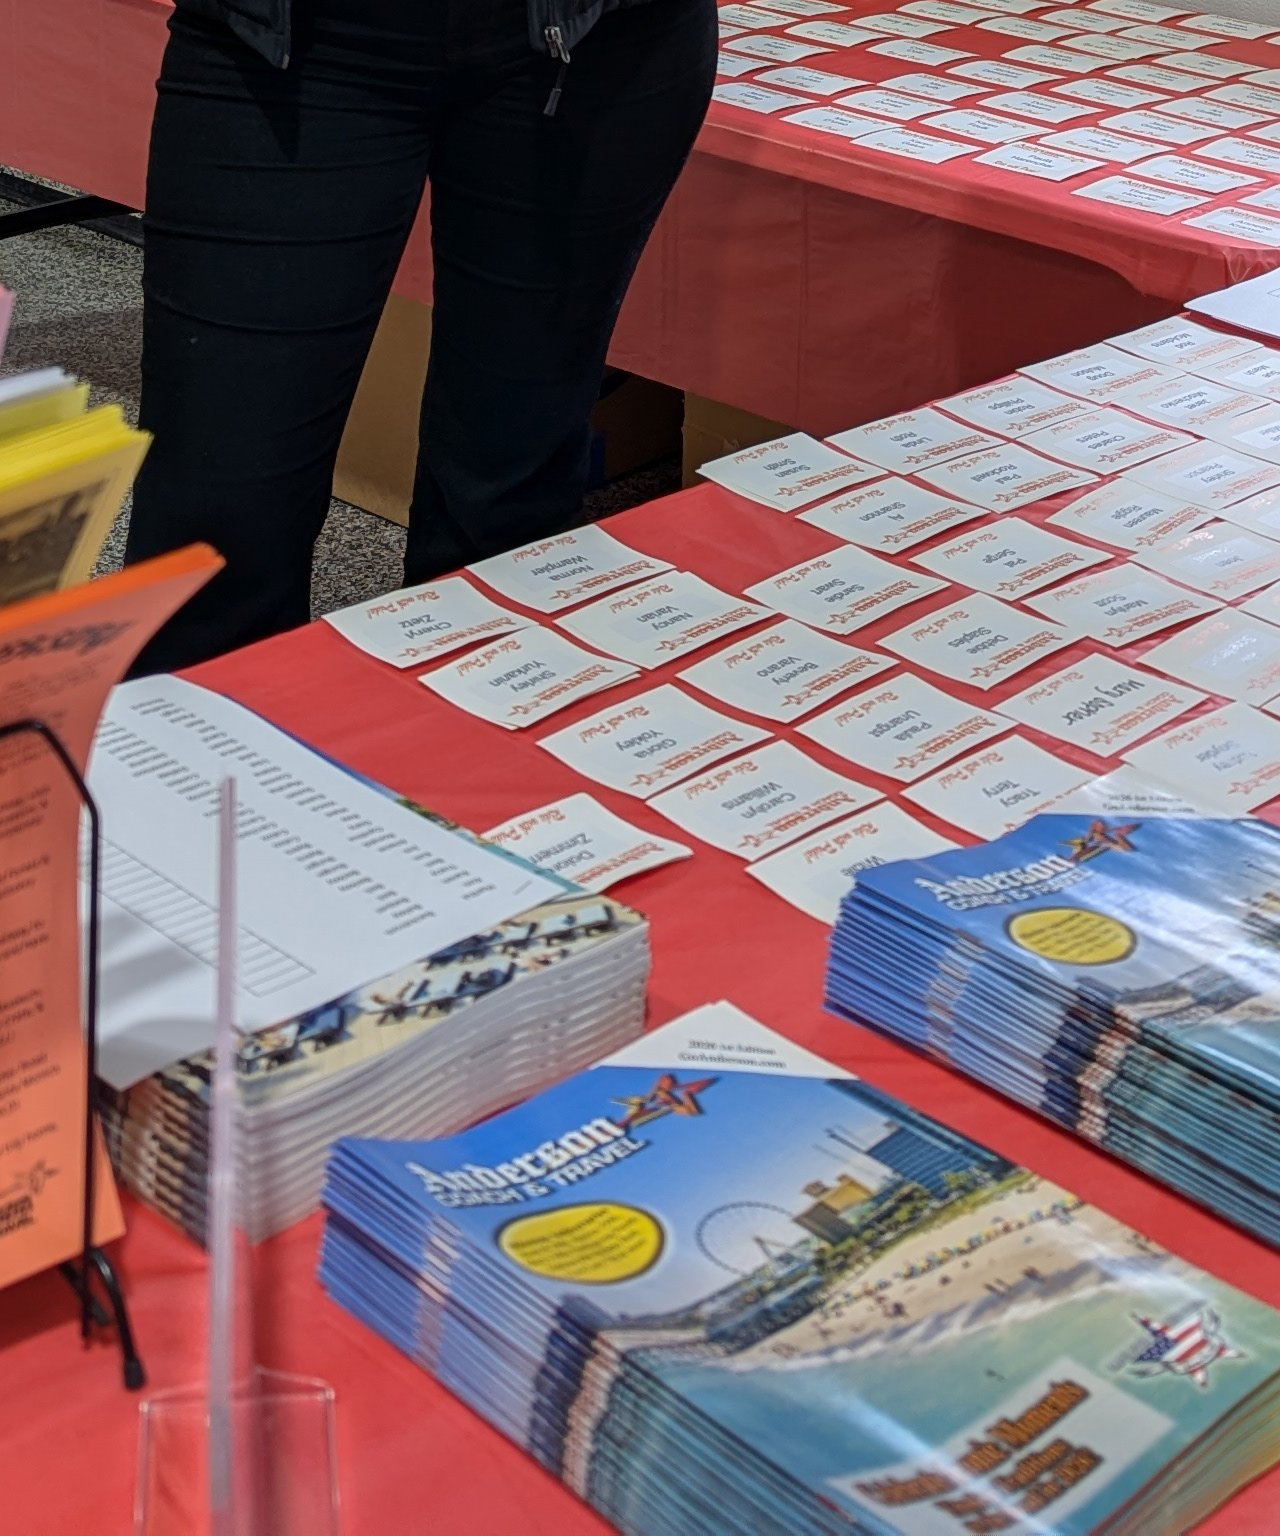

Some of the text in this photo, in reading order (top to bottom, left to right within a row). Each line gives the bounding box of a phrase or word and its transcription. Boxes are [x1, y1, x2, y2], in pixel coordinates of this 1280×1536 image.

[1084, 368, 1117, 382] Doug
[986, 393, 1025, 412] Phillips
[889, 430, 918, 443] Roth
[899, 435, 933, 450] Linda
[1086, 434, 1126, 452] Charles
[762, 456, 797, 472] Smith
[775, 464, 811, 479] Susan
[969, 462, 1018, 484] Rockwell
[1199, 466, 1237, 485] Shirley
[994, 472, 1022, 485] Paul
[858, 501, 906, 523] Shannon
[1122, 507, 1164, 529] Maureen
[530, 554, 588, 578] Wampler
[548, 564, 594, 584] Norma
[576, 559, 655, 590] Anderson
[1002, 556, 1028, 570] Pat
[1022, 551, 1085, 585] Anderson
[366, 589, 440, 619] Ride with Pride!
[824, 583, 866, 605] Sandie
[853, 580, 919, 614] Anderson
[1091, 593, 1128, 608] Scott
[635, 605, 679, 625] Varian
[1102, 598, 1149, 618] Marilyn
[404, 620, 453, 641] Cheryl
[432, 617, 516, 648] Anderson
[649, 611, 693, 632] Nancy
[946, 625, 993, 651] Staples
[964, 632, 1009, 657] Debbie
[456, 639, 522, 676] Ride with Pride!
[756, 654, 801, 679] Varano
[488, 658, 546, 689] Yurkanin
[509, 669, 557, 694] Shirley
[539, 665, 612, 703] Anderson
[771, 661, 819, 687] Beverly
[579, 705, 650, 742] Ride with Pride!
[866, 709, 922, 740] Unangst
[892, 720, 933, 744] Paula
[615, 727, 664, 753] Yokley
[632, 737, 678, 760] Gloria
[664, 732, 744, 773] Anderson
[683, 761, 759, 799] Ride with Pride!
[981, 777, 1021, 800] Terry
[720, 781, 783, 812] Williams
[739, 790, 797, 820] Carolyn
[999, 787, 1041, 810] Tracy
[772, 790, 857, 835] Anderson
[914, 854, 1076, 902] Anderson
[405, 1116, 626, 1196] Anderson
[434, 1136, 651, 1208] COACH & TRAVEL
